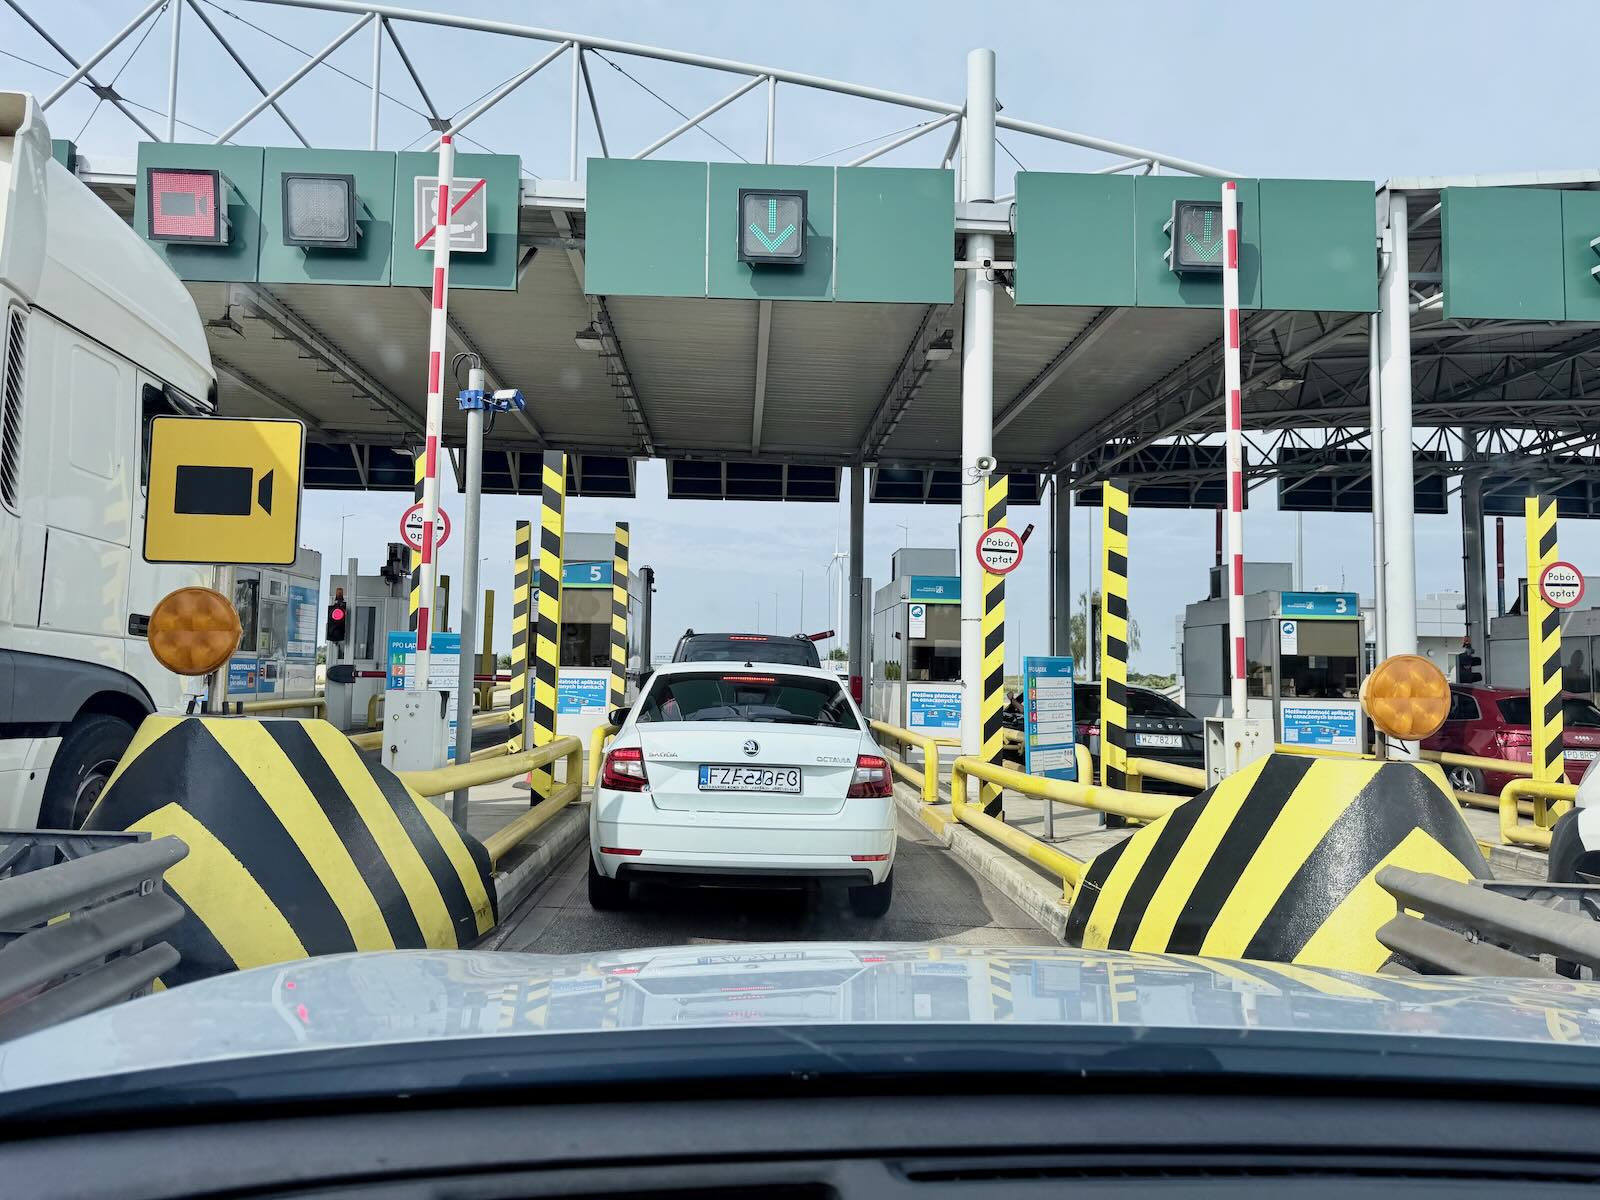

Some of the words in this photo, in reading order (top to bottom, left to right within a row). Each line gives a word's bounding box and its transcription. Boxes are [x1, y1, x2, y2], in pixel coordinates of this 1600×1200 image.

[411, 513, 441, 523] Por
[986, 537, 1014, 547] Pobór
[986, 555, 1012, 564] opłat
[590, 566, 602, 581] 5
[1548, 572, 1575, 581] Pobór
[1550, 589, 1575, 599] opłat
[1335, 598, 1347, 613] 3
[1141, 736, 1153, 744] WZ
[816, 756, 852, 764] OCTAVIA
